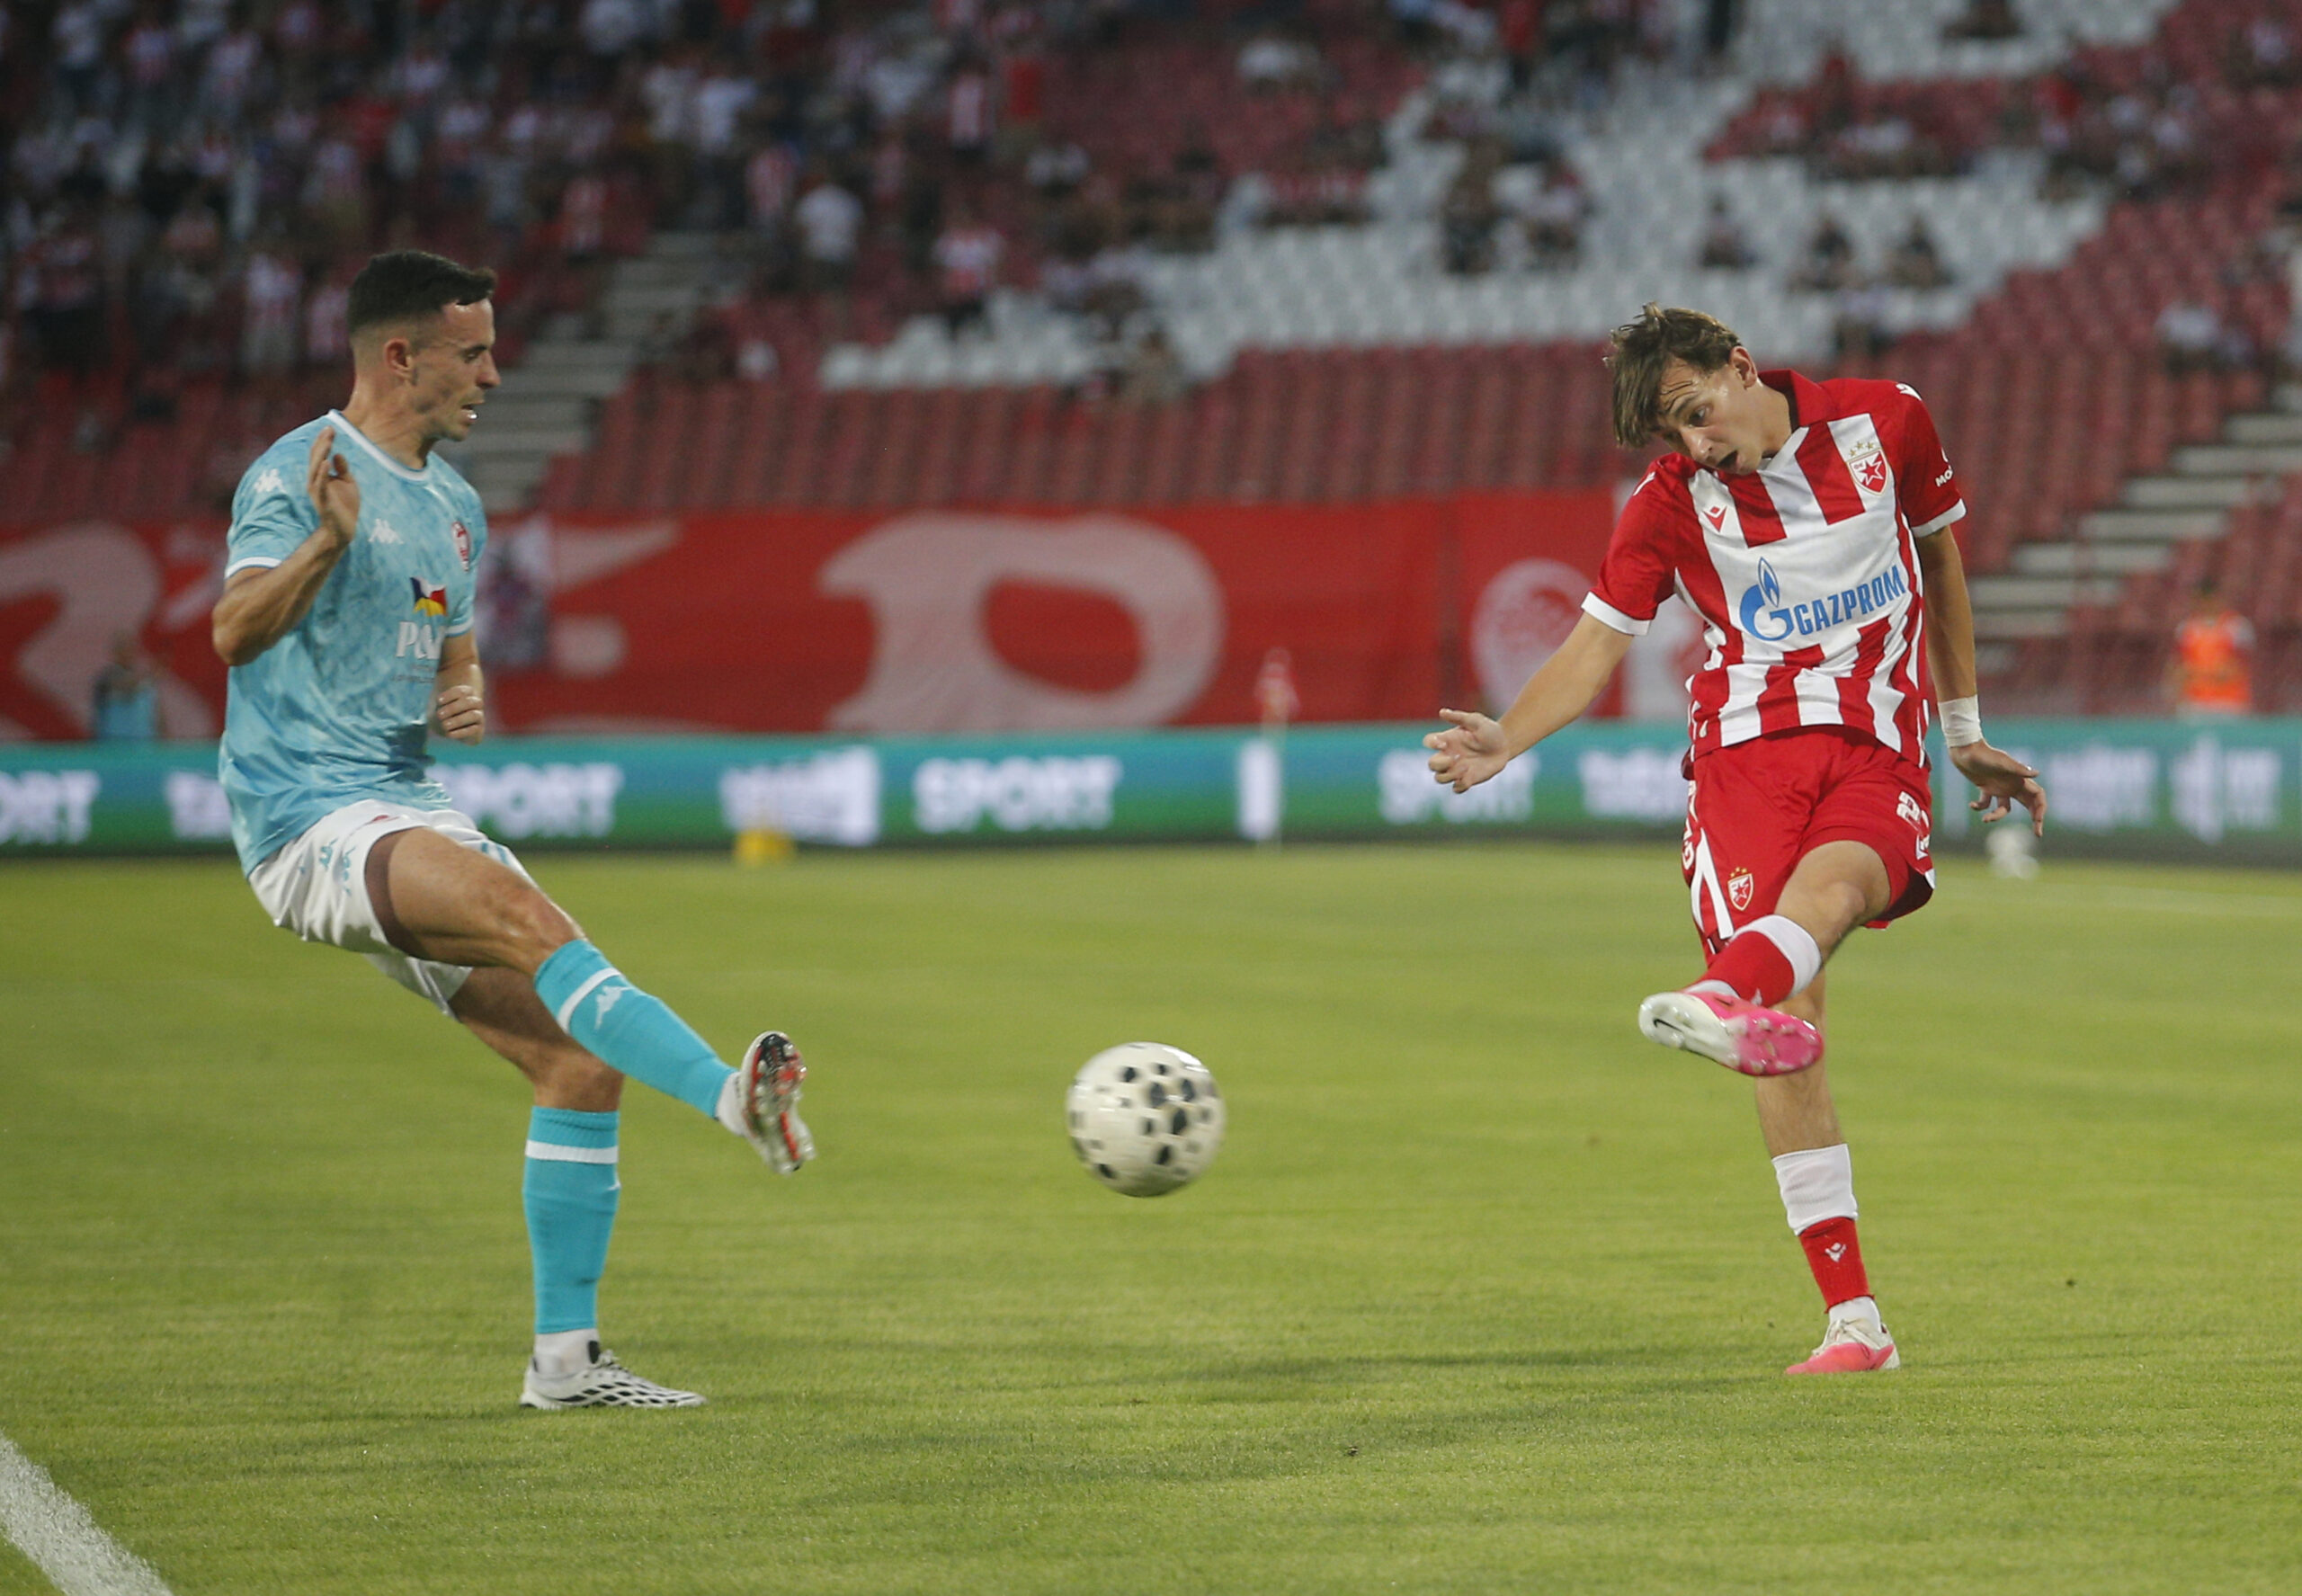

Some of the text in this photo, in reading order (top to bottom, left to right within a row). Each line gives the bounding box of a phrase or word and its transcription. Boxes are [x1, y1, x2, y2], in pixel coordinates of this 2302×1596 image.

[1935, 464, 1954, 487] MO
[1792, 565, 1906, 636] GAZPROM
[425, 762, 624, 838] PORT
[914, 753, 1121, 834] SPORT
